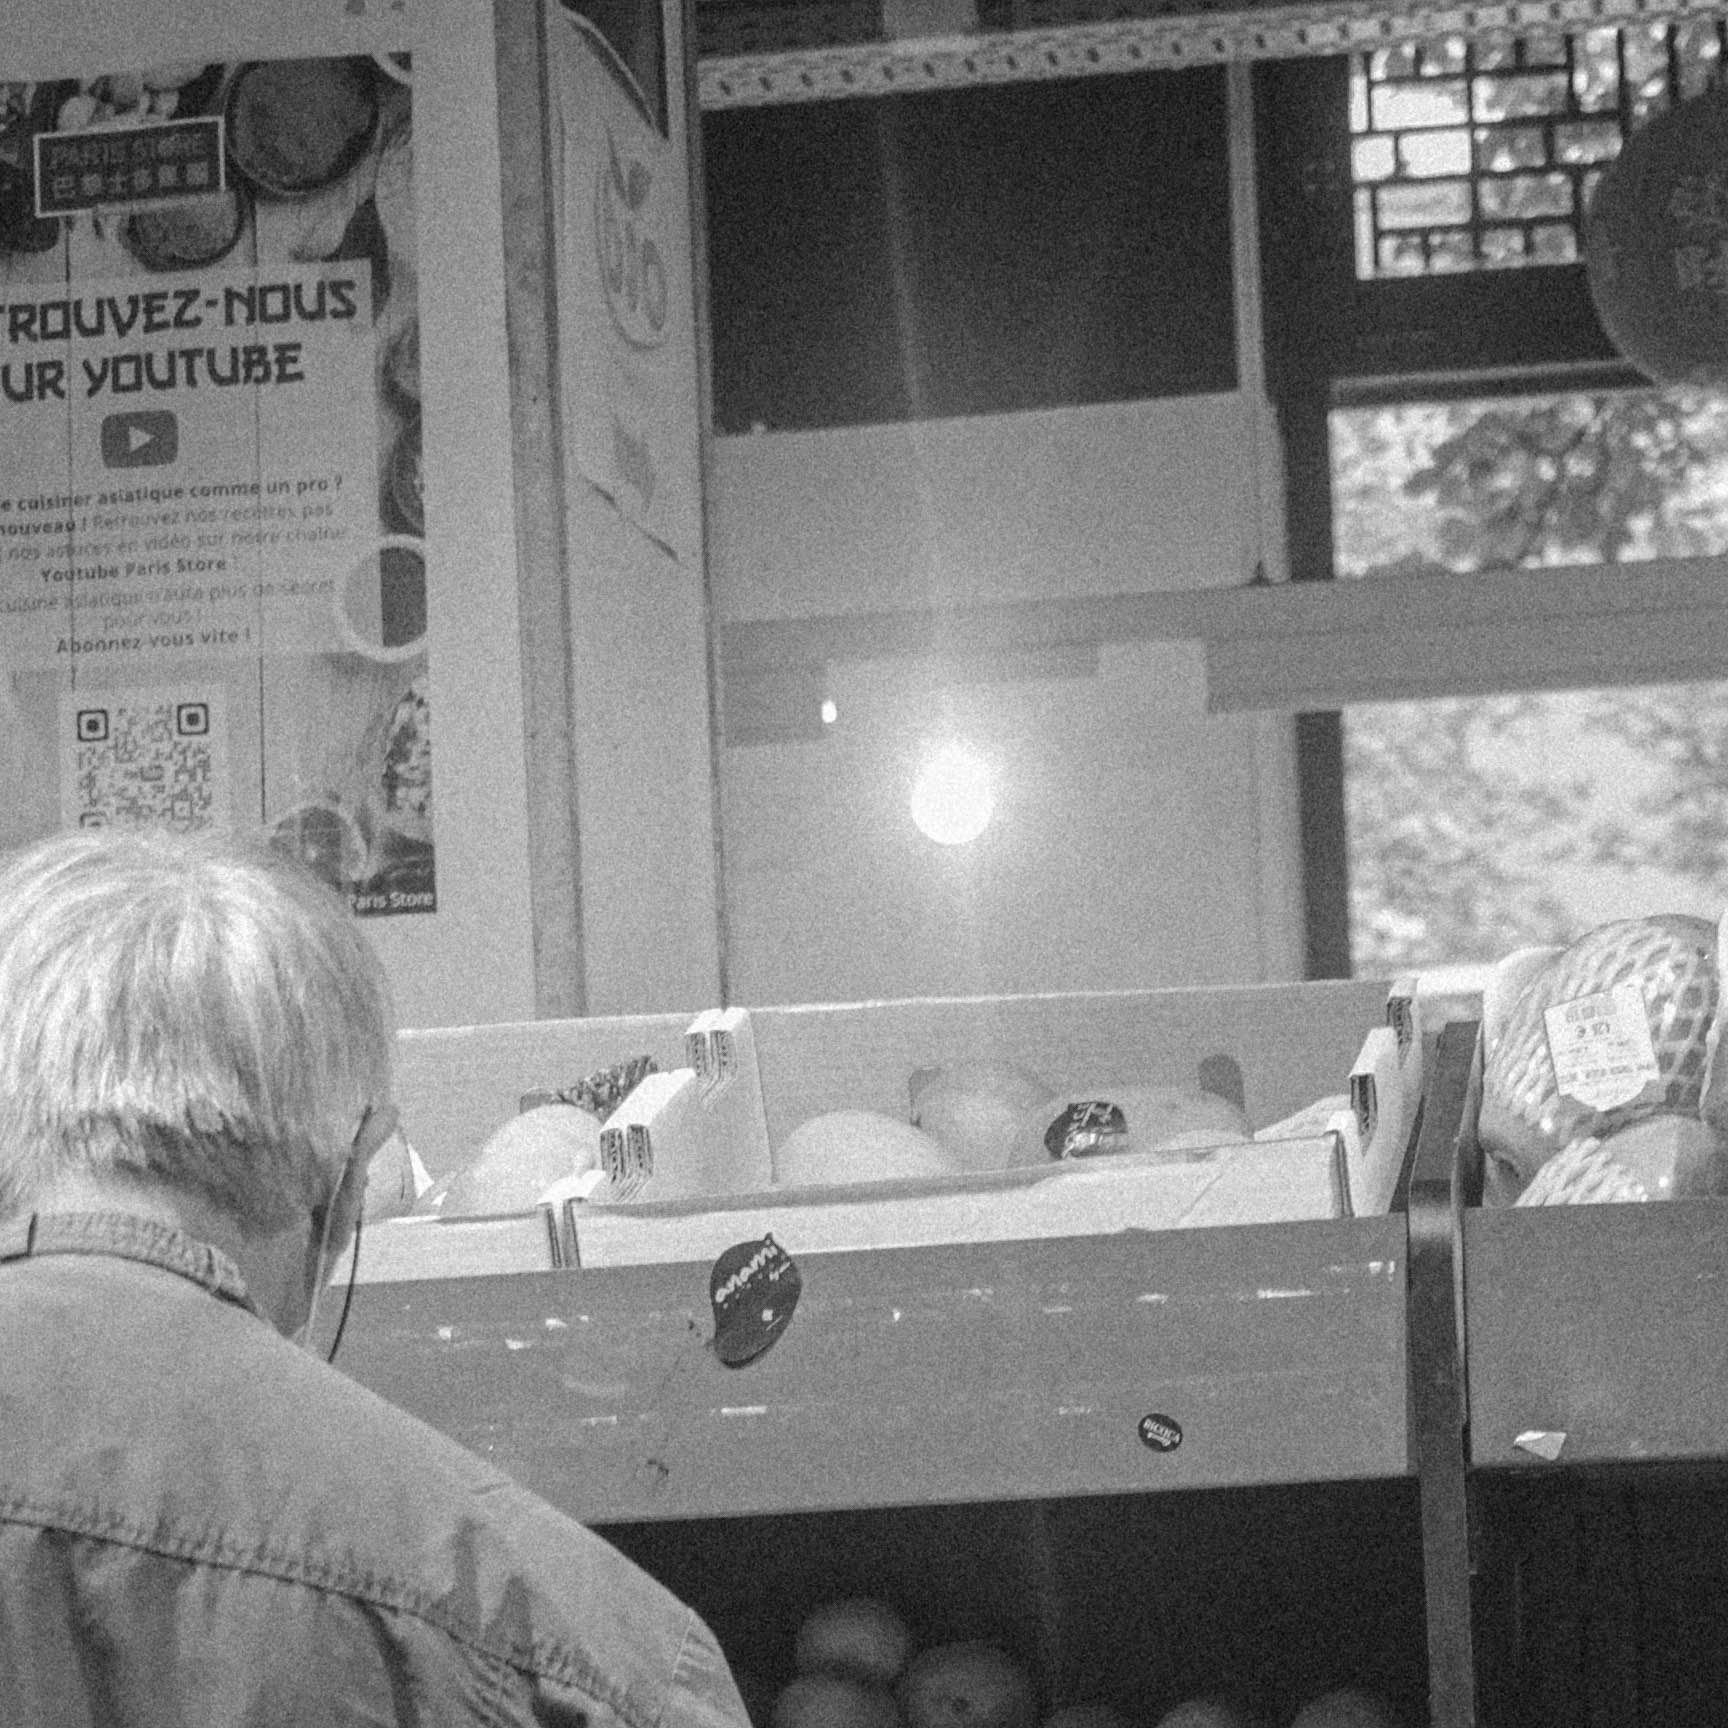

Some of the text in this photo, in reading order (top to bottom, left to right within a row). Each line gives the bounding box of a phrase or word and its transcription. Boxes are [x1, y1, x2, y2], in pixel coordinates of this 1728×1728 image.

[82, 342, 305, 398] YOUTUBE
[17, 492, 91, 512] cuisiner
[98, 485, 185, 505] asiatique
[190, 483, 261, 499] comme
[267, 479, 291, 495] un
[296, 479, 329, 498] pro
[41, 564, 120, 584] Youtube
[125, 561, 171, 578] Paris
[176, 557, 227, 574] Store
[201, 628, 240, 645] vite
[389, 890, 434, 908] Store
